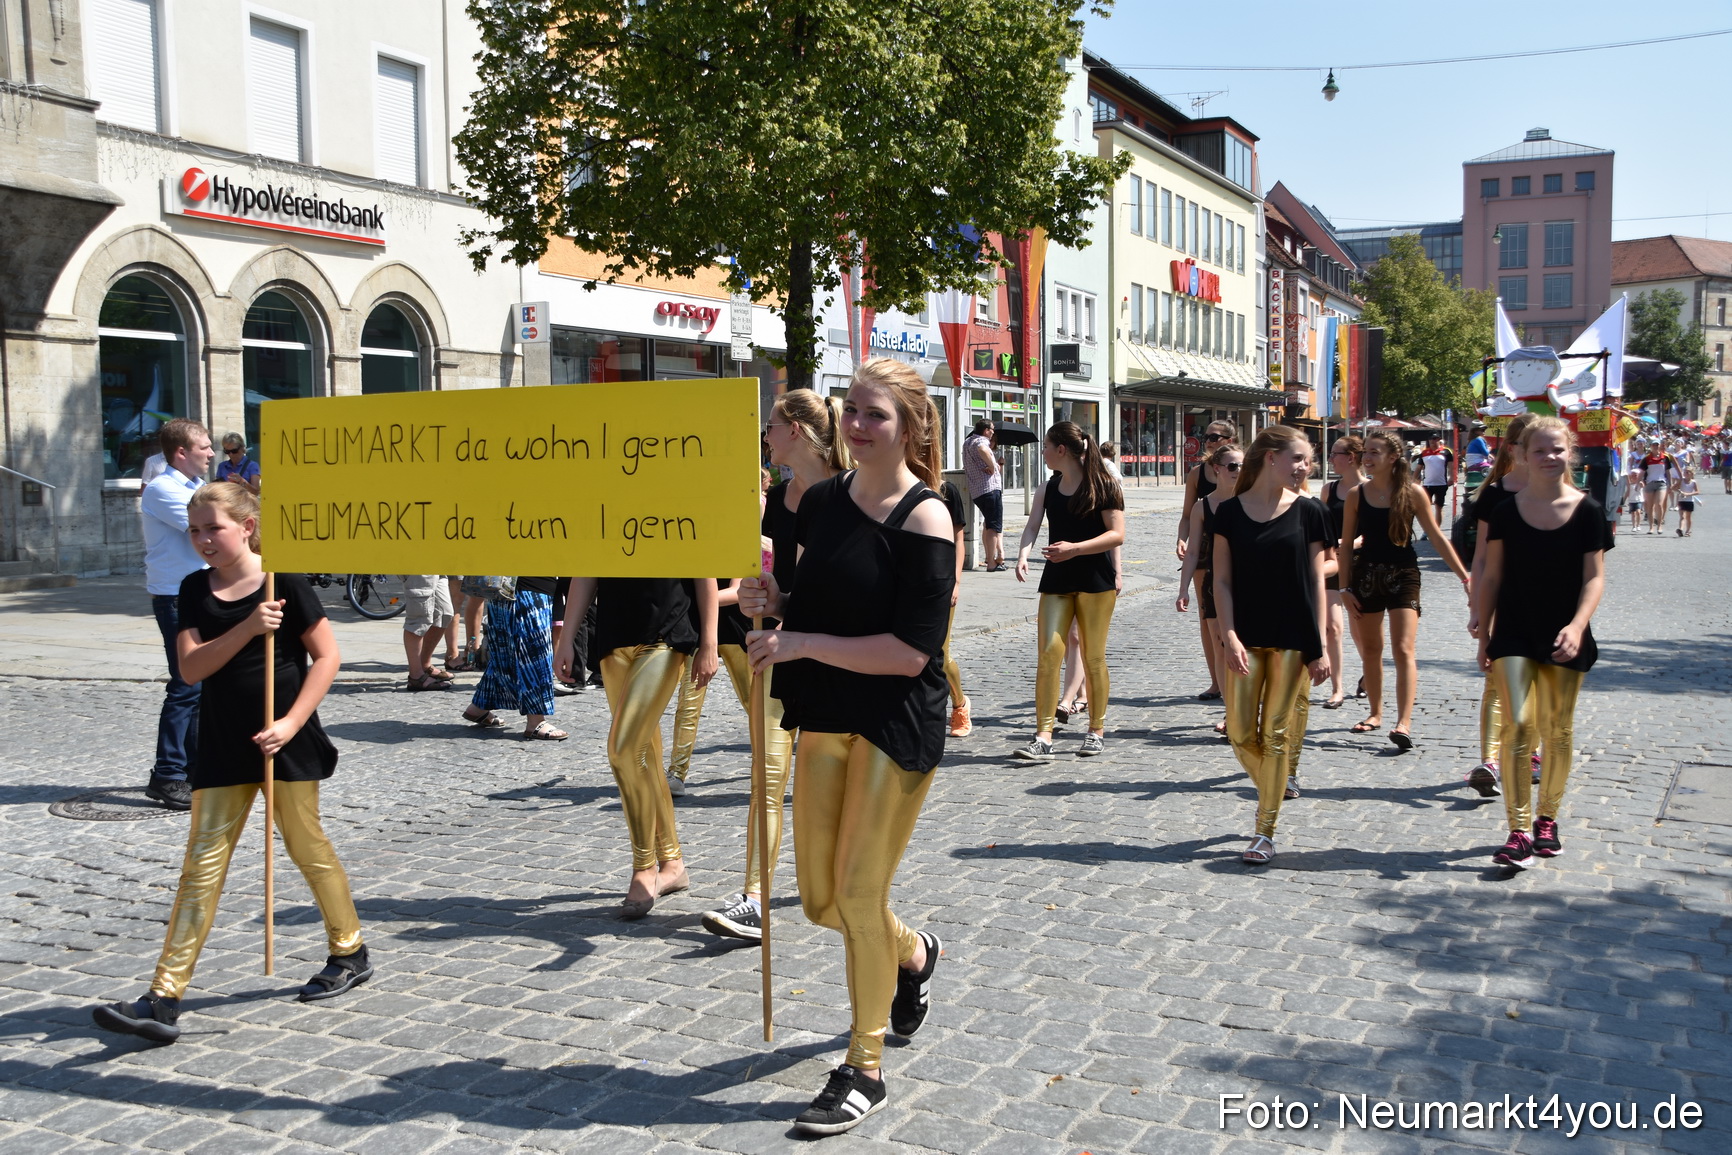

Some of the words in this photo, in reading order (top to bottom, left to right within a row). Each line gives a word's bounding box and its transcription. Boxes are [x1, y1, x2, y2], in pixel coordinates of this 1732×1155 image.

[213, 174, 385, 231] HypoVereinsbank
[656, 301, 721, 335] orsay
[1271, 270, 1280, 361] BÄCKEREI
[279, 423, 447, 466] NEUMARKT
[456, 428, 490, 462] da
[505, 423, 590, 460] wohn
[621, 434, 704, 476] gern
[279, 501, 433, 541] NEUMARKT
[444, 505, 477, 541] da
[505, 501, 568, 540] turn
[621, 514, 698, 557] gern
